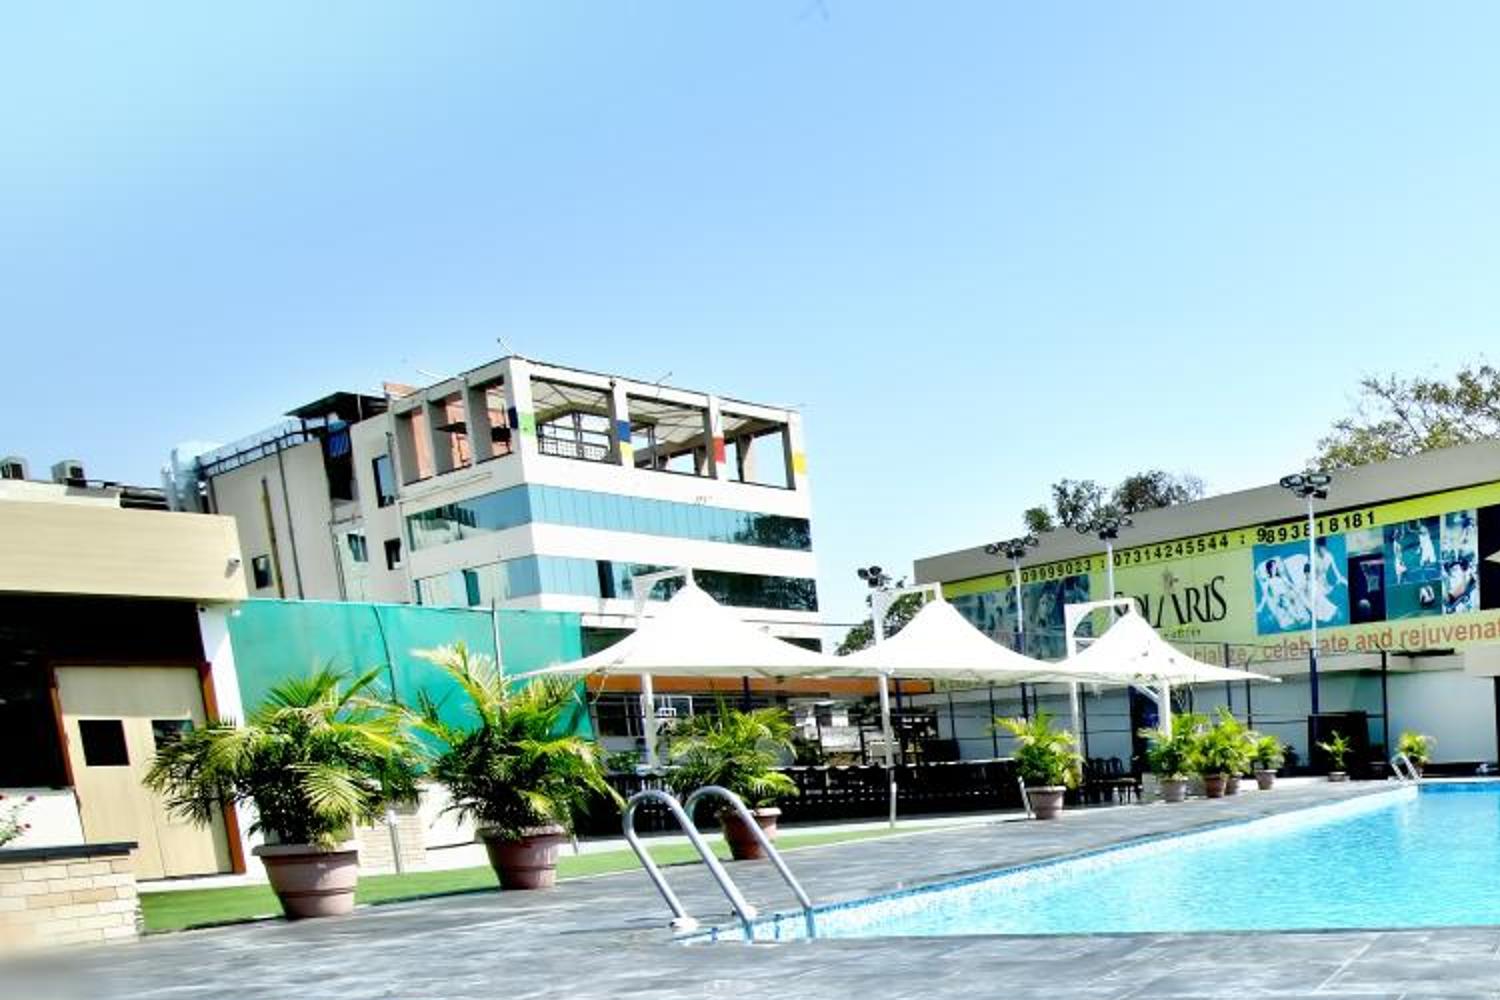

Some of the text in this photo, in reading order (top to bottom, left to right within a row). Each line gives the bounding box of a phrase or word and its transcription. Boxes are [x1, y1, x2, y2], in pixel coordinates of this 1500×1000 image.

[1005, 559, 1091, 586] 909999023
[1263, 633, 1349, 661] celebate
[1355, 628, 1393, 650] and
